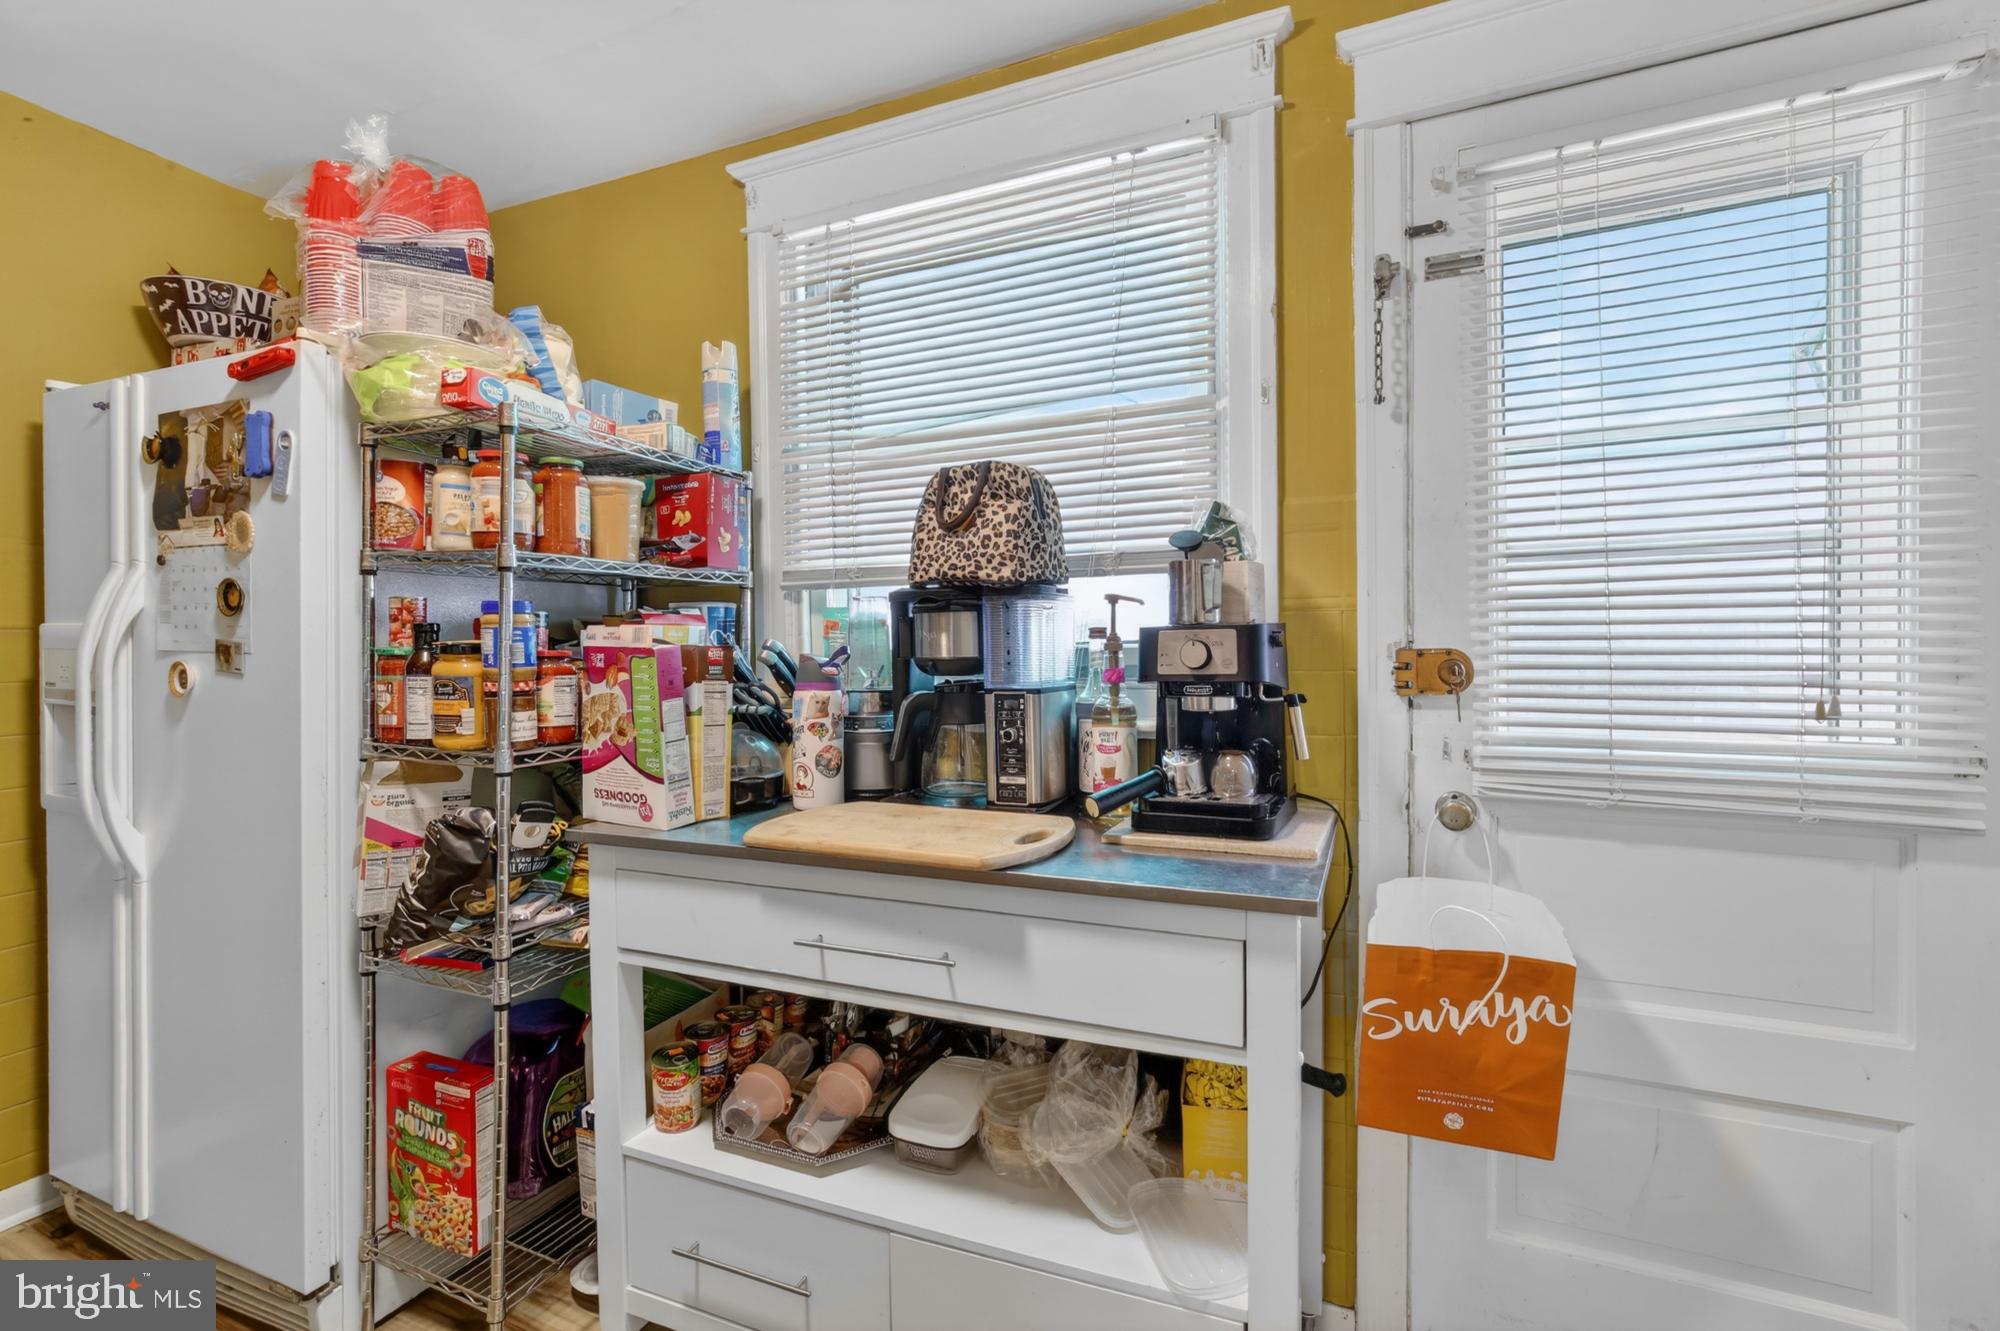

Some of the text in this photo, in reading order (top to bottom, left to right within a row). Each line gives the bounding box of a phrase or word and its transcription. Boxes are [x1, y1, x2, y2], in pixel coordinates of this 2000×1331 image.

[593, 787, 648, 805] GOODNESS
[408, 1100, 443, 1126] FRUIT
[395, 1109, 458, 1151] ROUNDS
